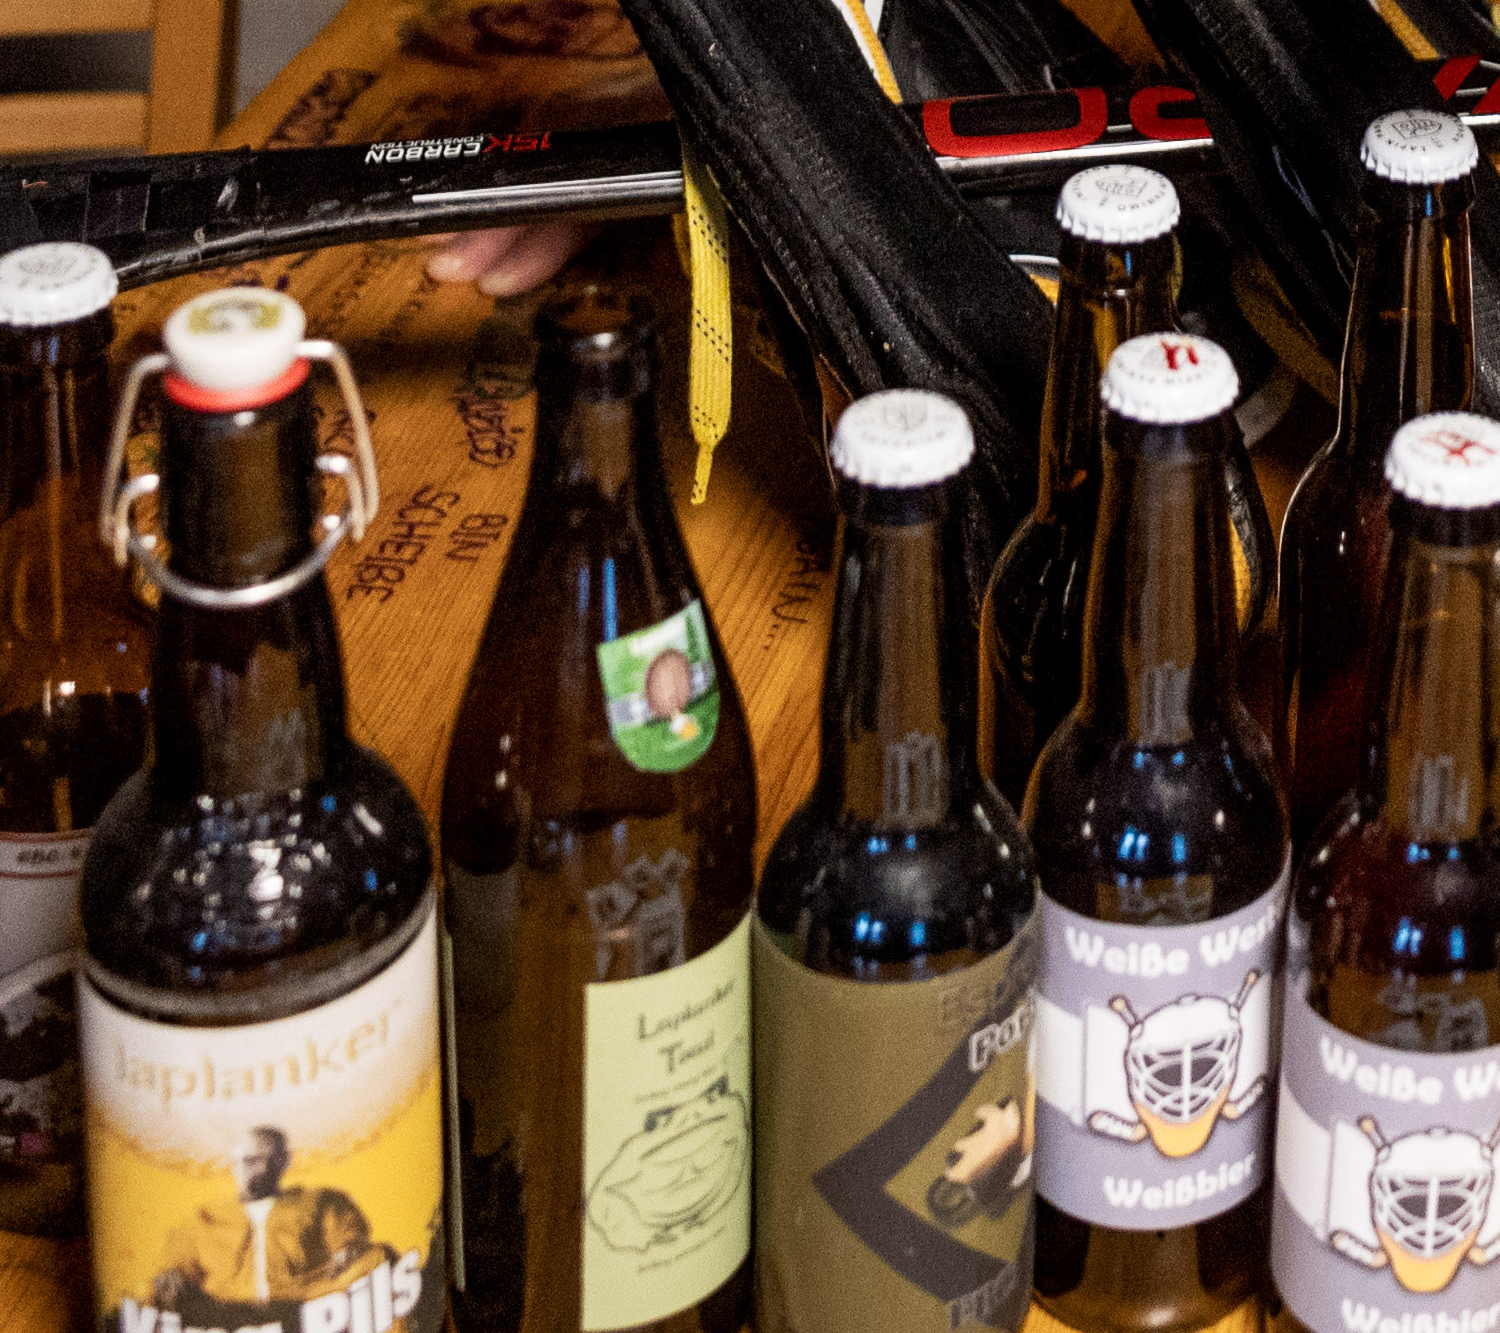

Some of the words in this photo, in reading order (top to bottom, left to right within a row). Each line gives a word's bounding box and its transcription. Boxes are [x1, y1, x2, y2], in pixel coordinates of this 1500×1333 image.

[364, 142, 482, 166] CARBON
[369, 134, 485, 151] CONSTRUCTION
[1064, 925, 1191, 979] Weiße
[111, 1009, 391, 1109] laplanker
[1320, 1034, 1443, 1106] Weiße
